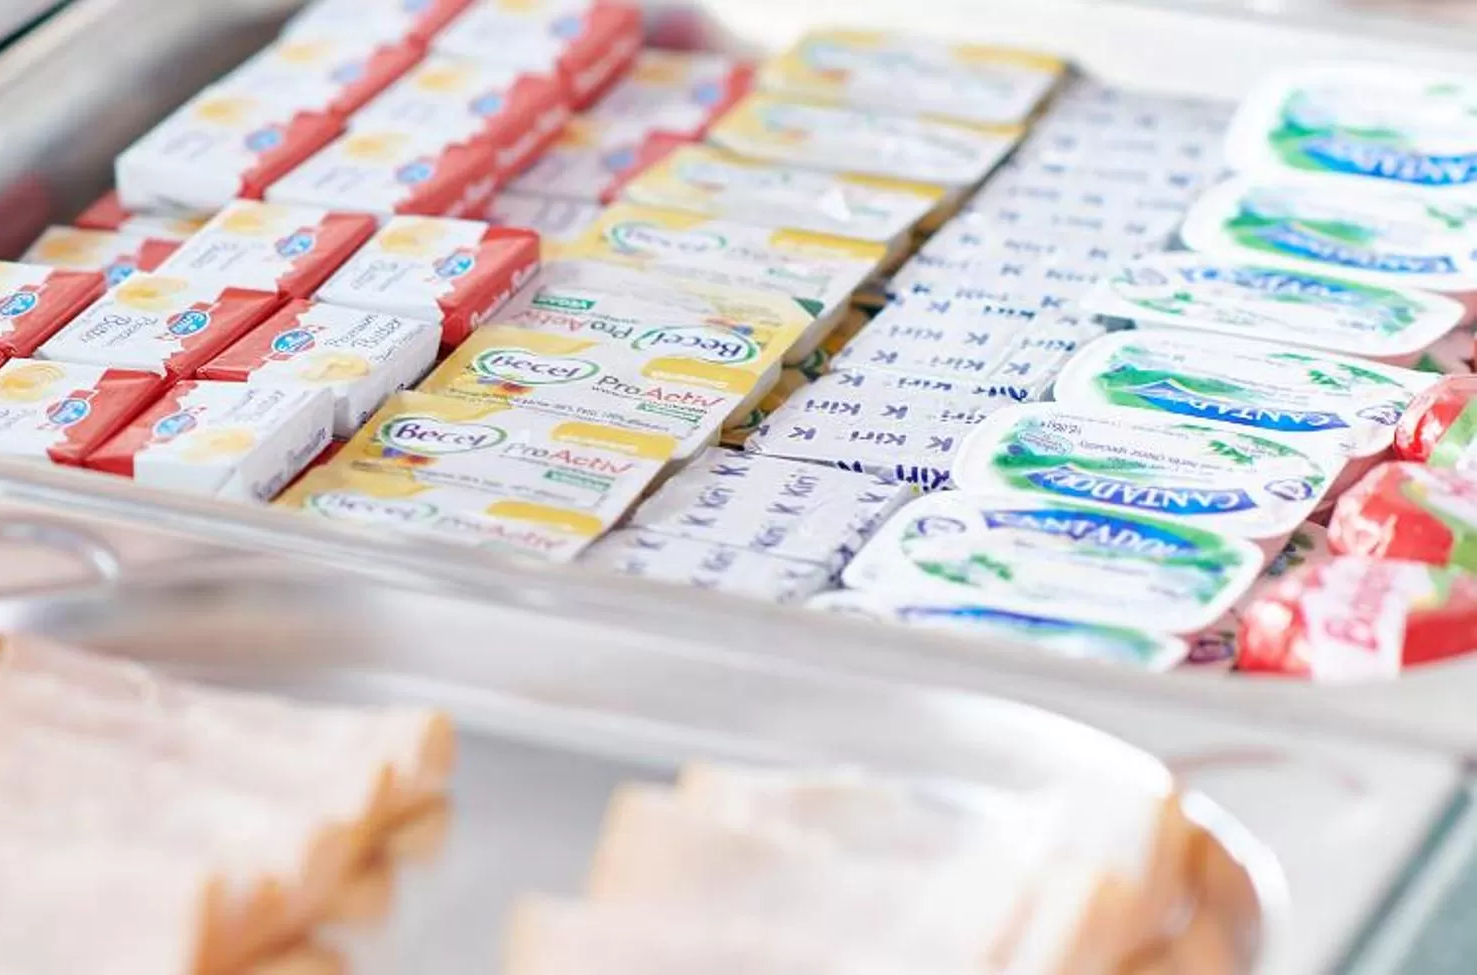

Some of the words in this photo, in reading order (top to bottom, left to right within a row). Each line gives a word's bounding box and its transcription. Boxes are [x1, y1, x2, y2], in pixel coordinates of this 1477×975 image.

[651, 330, 744, 359] Becel
[490, 354, 582, 379] Becel
[805, 398, 862, 417] Kiri
[394, 422, 488, 447] Becel
[709, 464, 751, 478] K
